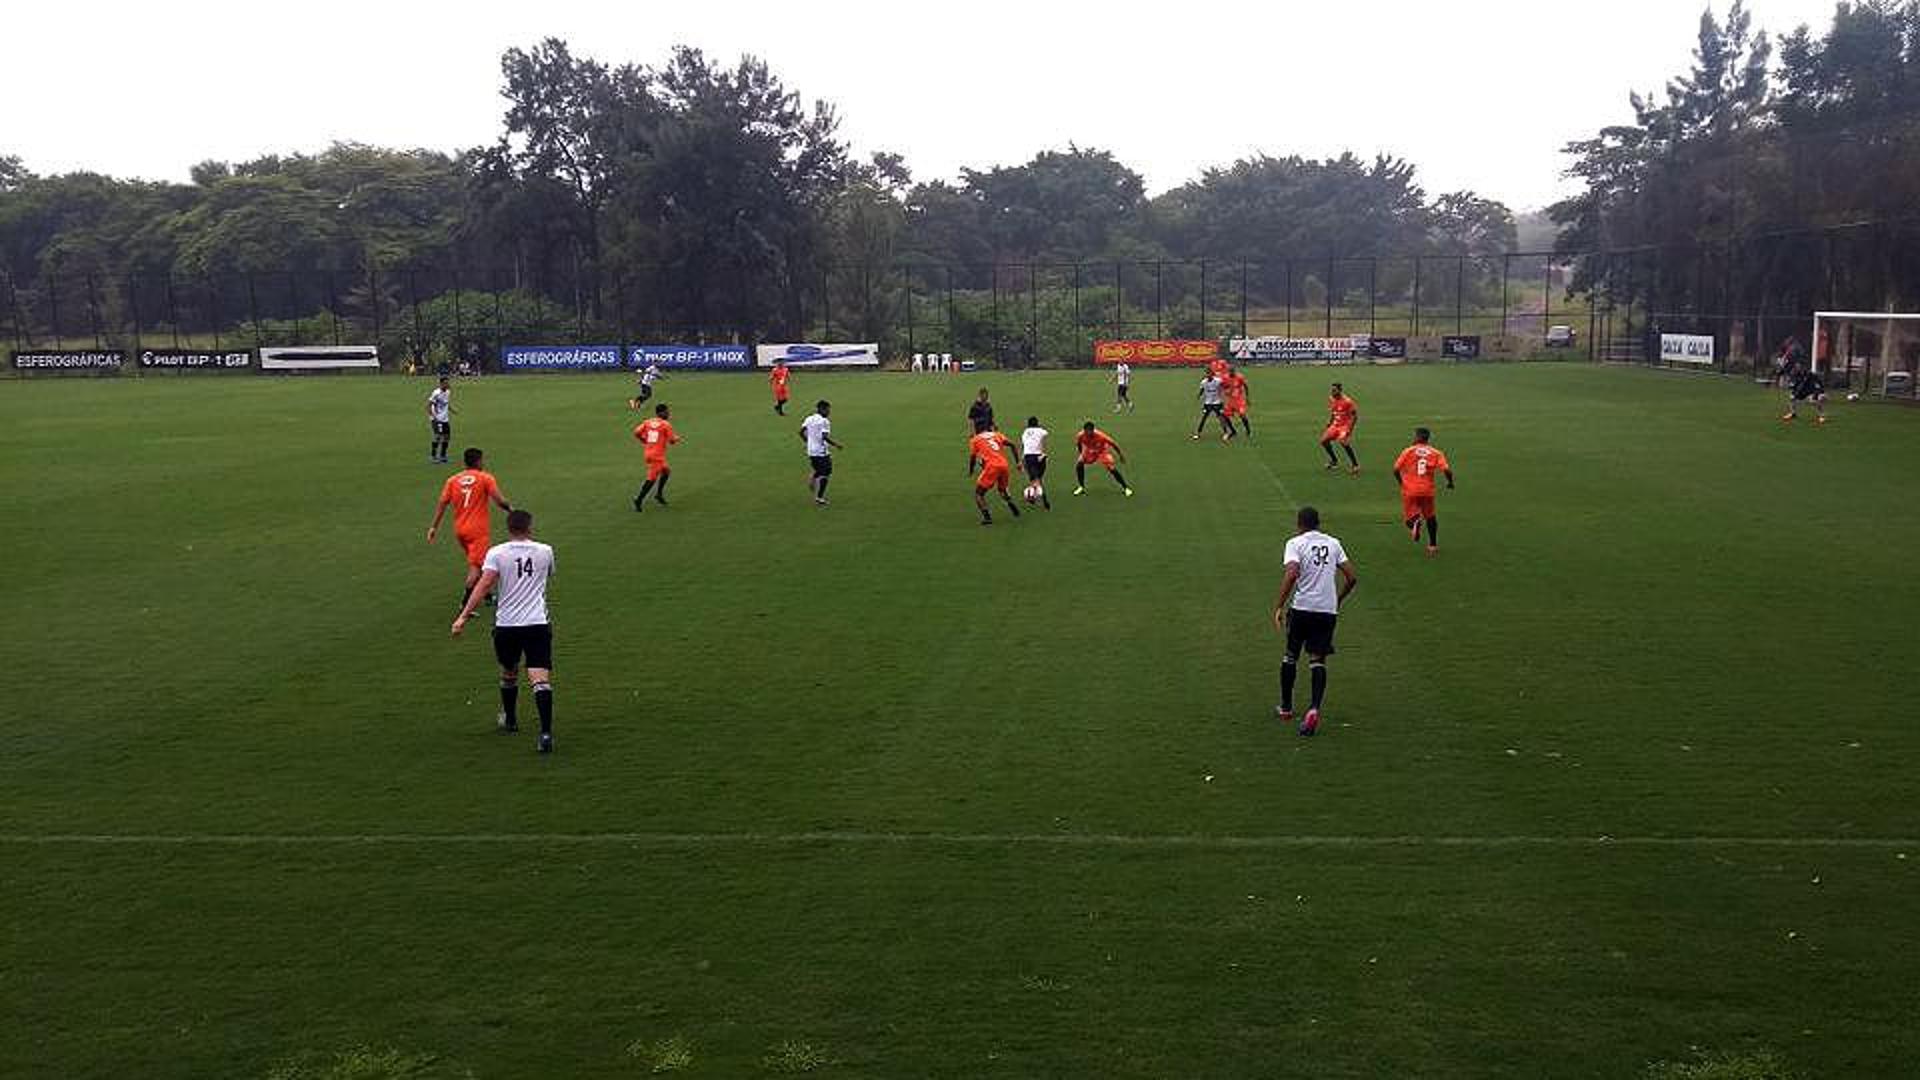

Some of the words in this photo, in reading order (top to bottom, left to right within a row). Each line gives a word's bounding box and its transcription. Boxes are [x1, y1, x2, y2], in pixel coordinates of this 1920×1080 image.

[16, 352, 121, 368] ESFEROGRÁFICAS
[507, 349, 616, 365] ESFEROGRÁFICAS
[712, 351, 746, 362] INOX
[461, 487, 472, 508] 7
[1311, 544, 1329, 567] 32
[514, 557, 533, 578] 14
